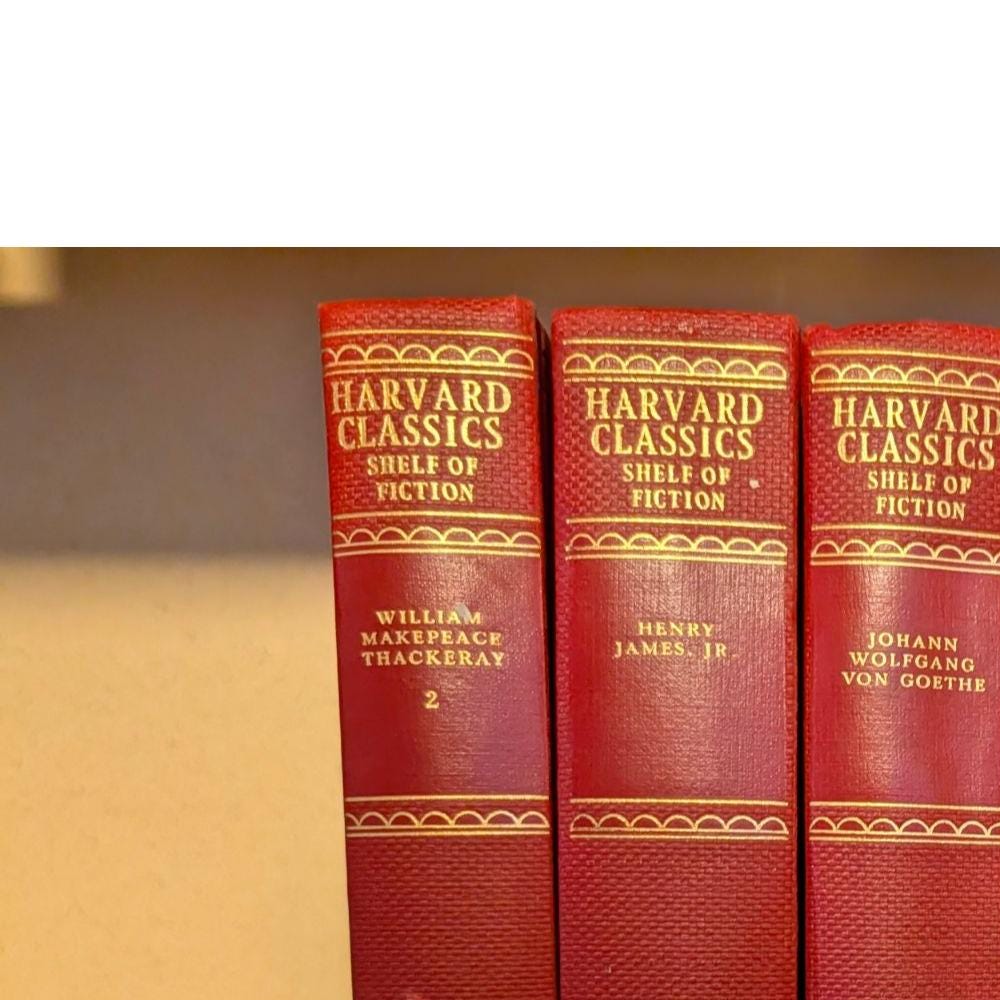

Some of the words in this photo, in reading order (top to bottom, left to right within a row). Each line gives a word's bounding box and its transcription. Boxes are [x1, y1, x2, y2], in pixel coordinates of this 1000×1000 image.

[331, 379, 512, 414] HARVARD
[586, 387, 764, 426] HARVARD
[337, 415, 503, 451] CLASSICS
[590, 423, 755, 460] CLASSICS
[837, 431, 995, 471] CLASSICS
[367, 455, 439, 476] SHELF
[448, 456, 479, 477] OF
[622, 463, 694, 485] SHELF
[701, 466, 731, 486] OF
[376, 481, 475, 502] FICTION
[867, 470, 937, 493] SHELF
[943, 475, 972, 495] OF
[631, 488, 726, 511] FICTION
[875, 496, 967, 520] FICTION
[375, 609, 483, 625] WILLIAM
[361, 630, 502, 647] MAKEPEACE
[637, 621, 714, 637] HENRY
[868, 631, 958, 652] JOHANN
[361, 650, 505, 667] THACKERAY
[849, 651, 975, 673] WOLFGANG
[841, 671, 889, 687] VON
[900, 673, 986, 693] GOETHE
[424, 689, 440, 709] 2
